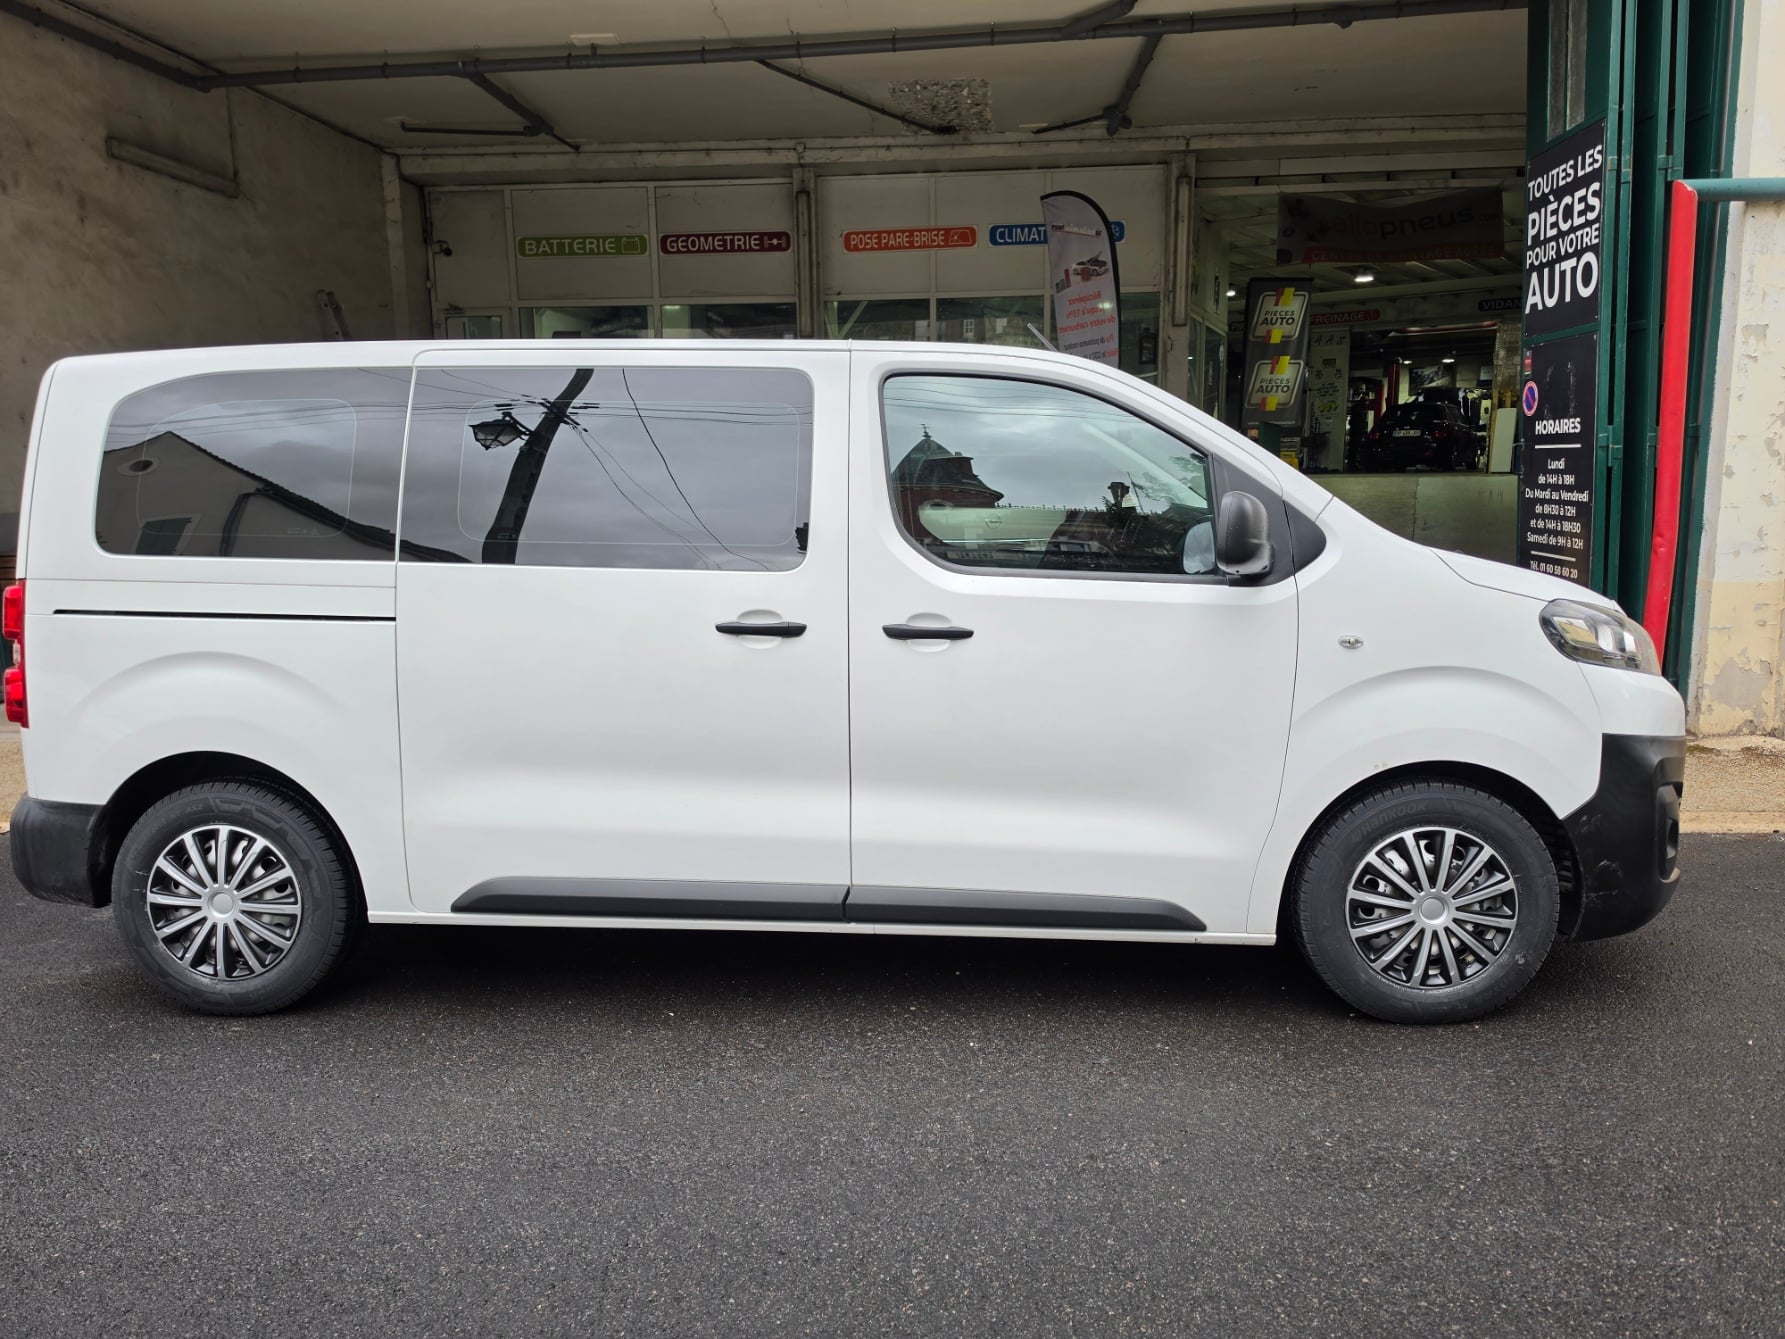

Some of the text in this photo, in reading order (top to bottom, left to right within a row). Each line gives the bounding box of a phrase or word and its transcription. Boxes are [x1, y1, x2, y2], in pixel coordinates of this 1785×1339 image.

[1528, 144, 1603, 202] TOUTES LES
[1527, 181, 1601, 247] PIÈCES
[666, 235, 760, 251] GEOMETRIE
[850, 230, 945, 250] POSE PARE-BRISE
[996, 227, 1048, 244] CLIMAT
[525, 238, 616, 255] BATTERIE
[1526, 222, 1600, 270] POUR VOTRE
[1525, 251, 1599, 315] AUTO
[1260, 317, 1295, 326] AUTO
[1255, 384, 1291, 394] AUTO
[1259, 377, 1291, 385] PIECES
[1535, 417, 1581, 435] HORAIRES
[1547, 457, 1565, 469] Lundi
[1538, 474, 1575, 485] de 14H à 18H
[1525, 488, 1589, 502] Du Mardi au Vendredi
[1535, 503, 1576, 517] de 8H30 à 12H
[1530, 518, 1581, 533] et de 14H à 18H30
[1527, 531, 1584, 550] Samedi de 9H à 12H
[1540, 562, 1546, 572] 01
[1570, 569, 1578, 579] 20
